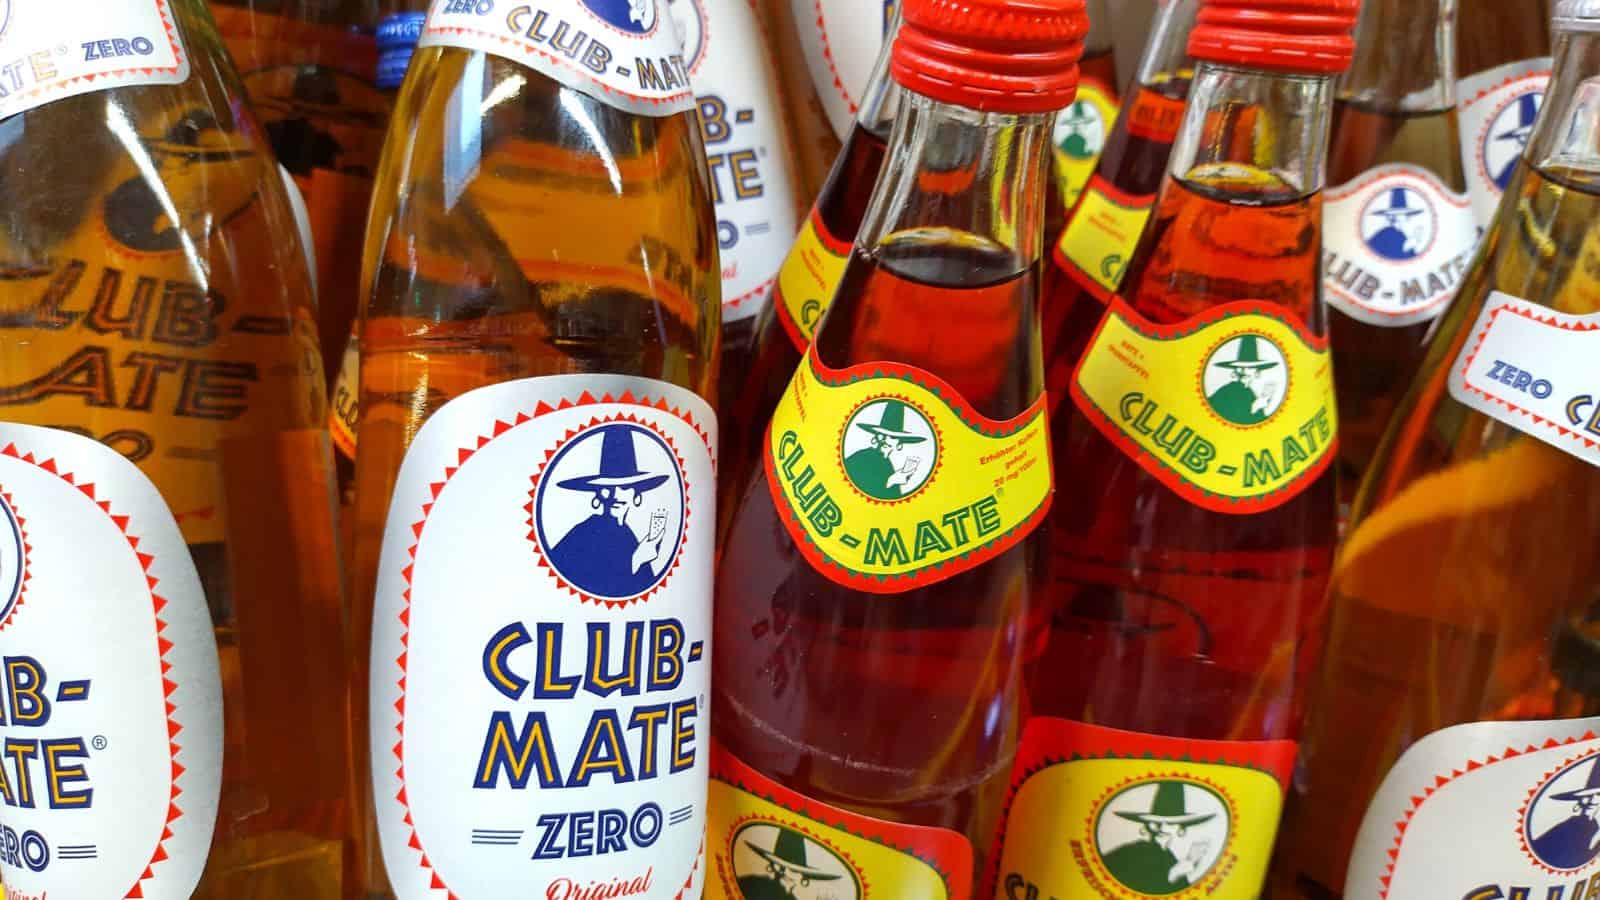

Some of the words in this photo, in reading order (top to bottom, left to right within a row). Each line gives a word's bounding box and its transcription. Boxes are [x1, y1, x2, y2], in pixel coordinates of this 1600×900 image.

[81, 37, 154, 61] ZERO
[1485, 360, 1553, 400] ZERO
[482, 618, 704, 701] CLUB-
[531, 801, 664, 860] ZERO
